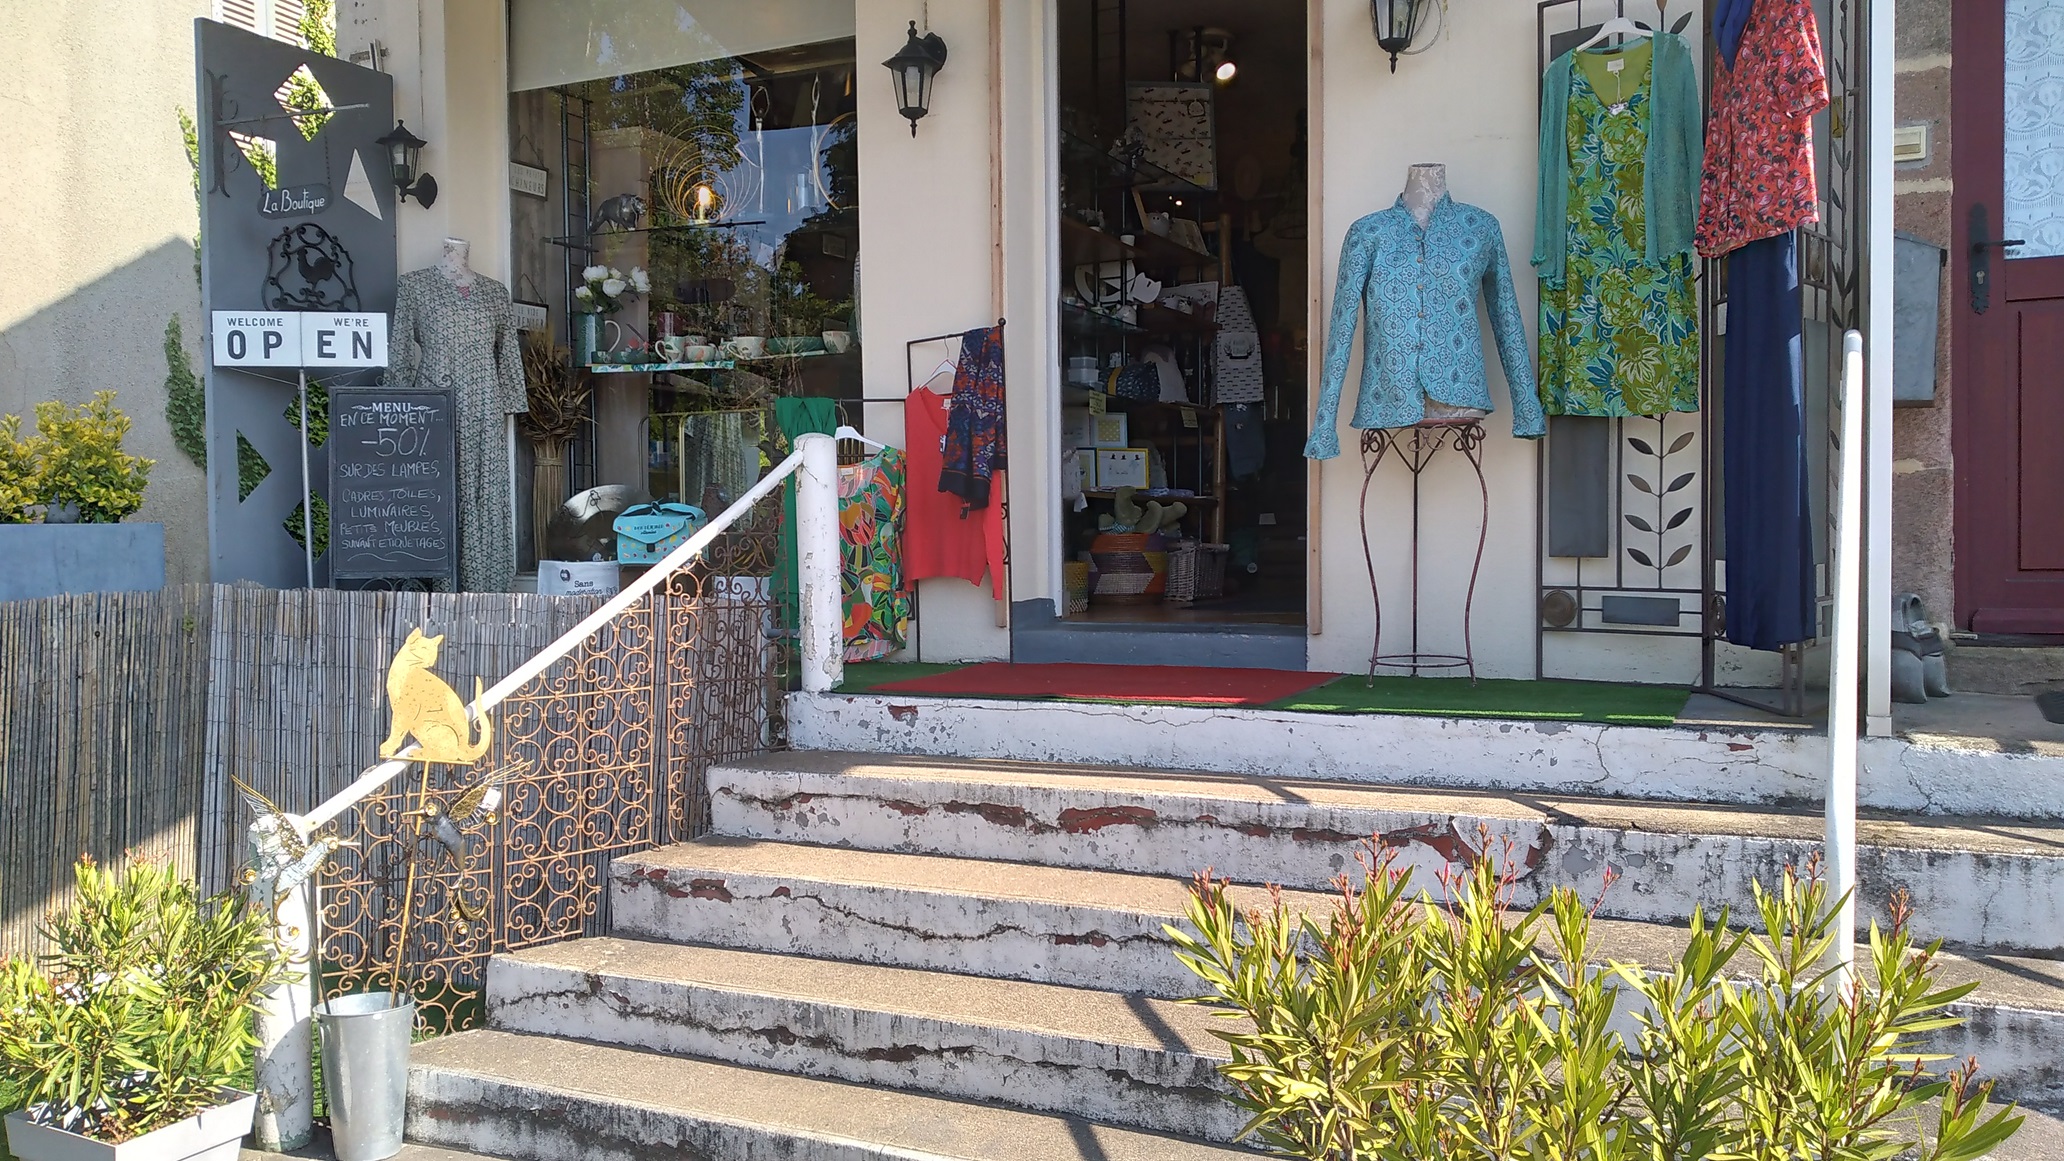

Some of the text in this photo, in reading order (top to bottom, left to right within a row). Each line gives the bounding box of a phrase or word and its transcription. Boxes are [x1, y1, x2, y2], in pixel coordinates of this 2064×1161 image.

[263, 188, 325, 214] La Boutique
[227, 317, 284, 327] WELCOME
[333, 317, 369, 328] WE'RE
[371, 402, 411, 413] MENU
[340, 411, 358, 427] EN
[360, 412, 375, 425] CE
[361, 426, 430, 457] -50%
[340, 460, 440, 478] SUR DES LAMPES,
[389, 487, 441, 503] TOILES,
[350, 503, 434, 521] LUMINAIRES,
[340, 520, 443, 536] PETITS MEUBLES,
[574, 580, 594, 588] Sans
